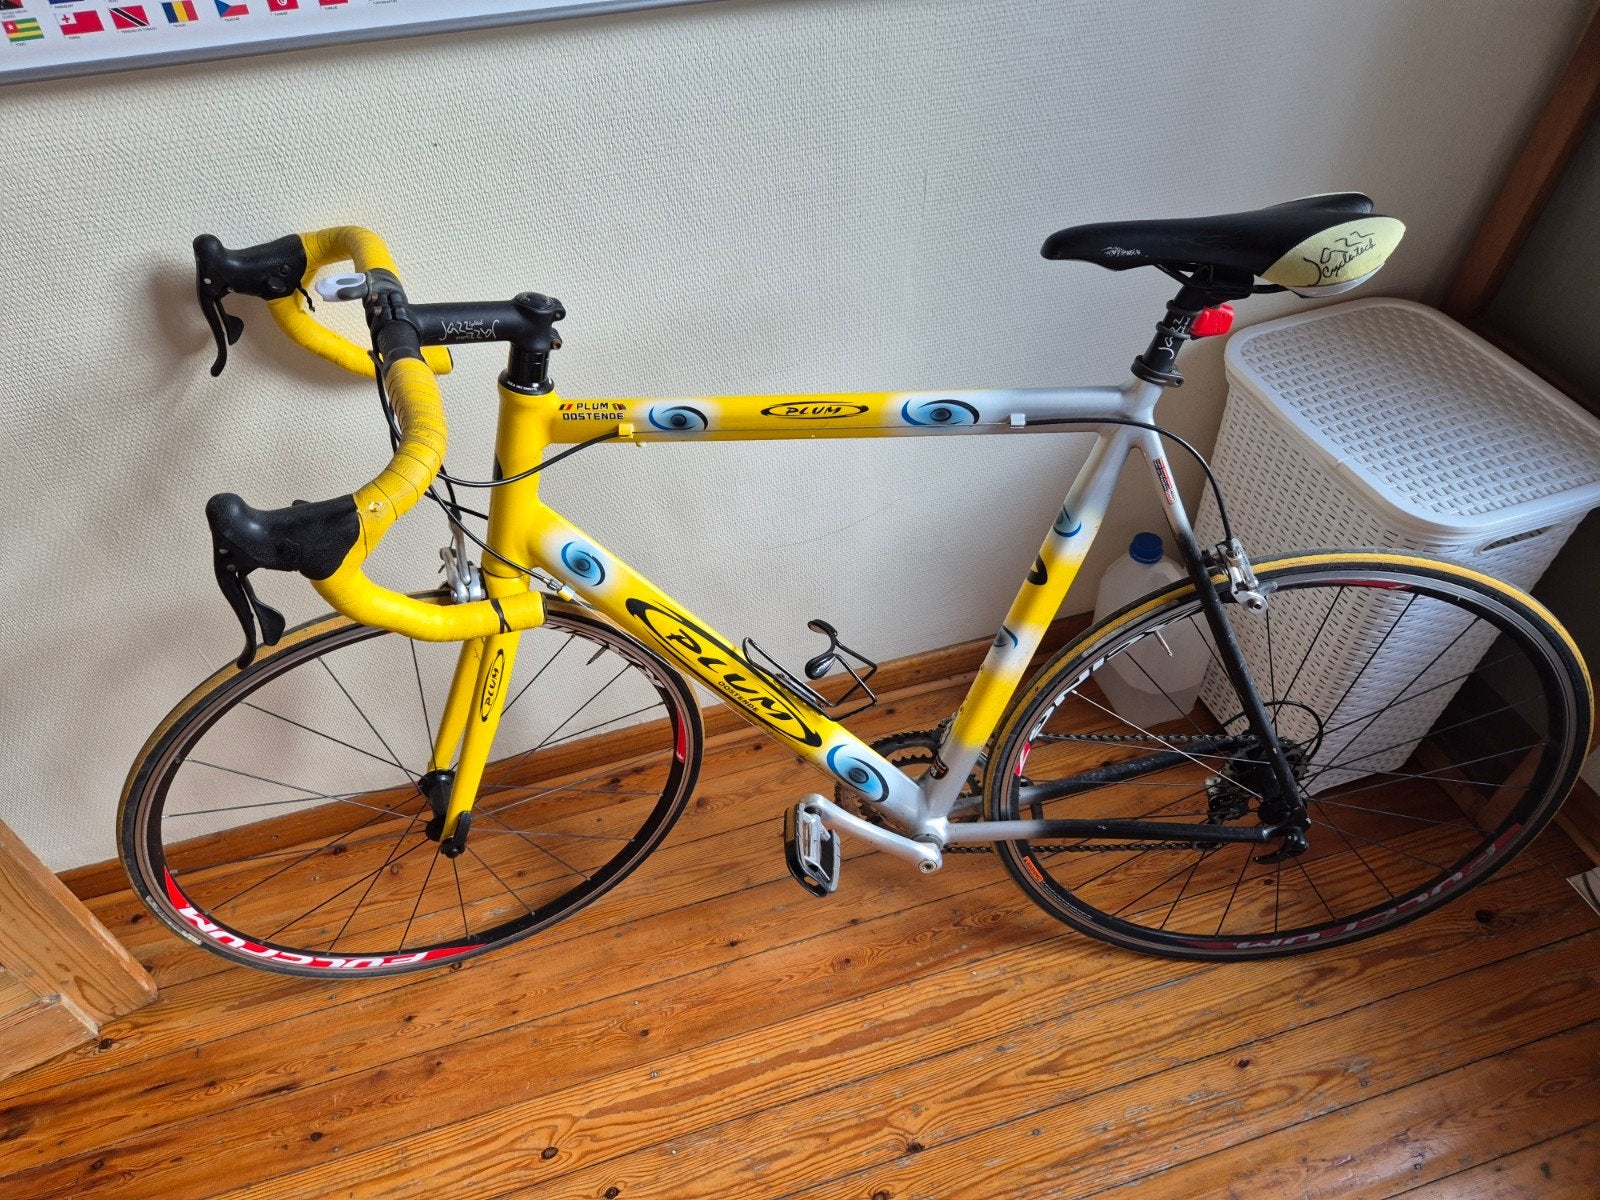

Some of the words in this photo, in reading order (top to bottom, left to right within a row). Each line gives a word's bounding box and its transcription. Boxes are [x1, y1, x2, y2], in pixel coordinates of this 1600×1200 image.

[562, 412, 624, 421] OOSTENDE
[576, 402, 609, 411] PLUM
[785, 404, 841, 416] PLUM
[484, 666, 500, 707] PLUM
[666, 628, 793, 721] PLUM
[717, 681, 759, 713] OOSTENDE
[178, 906, 430, 969] FULCRUM
